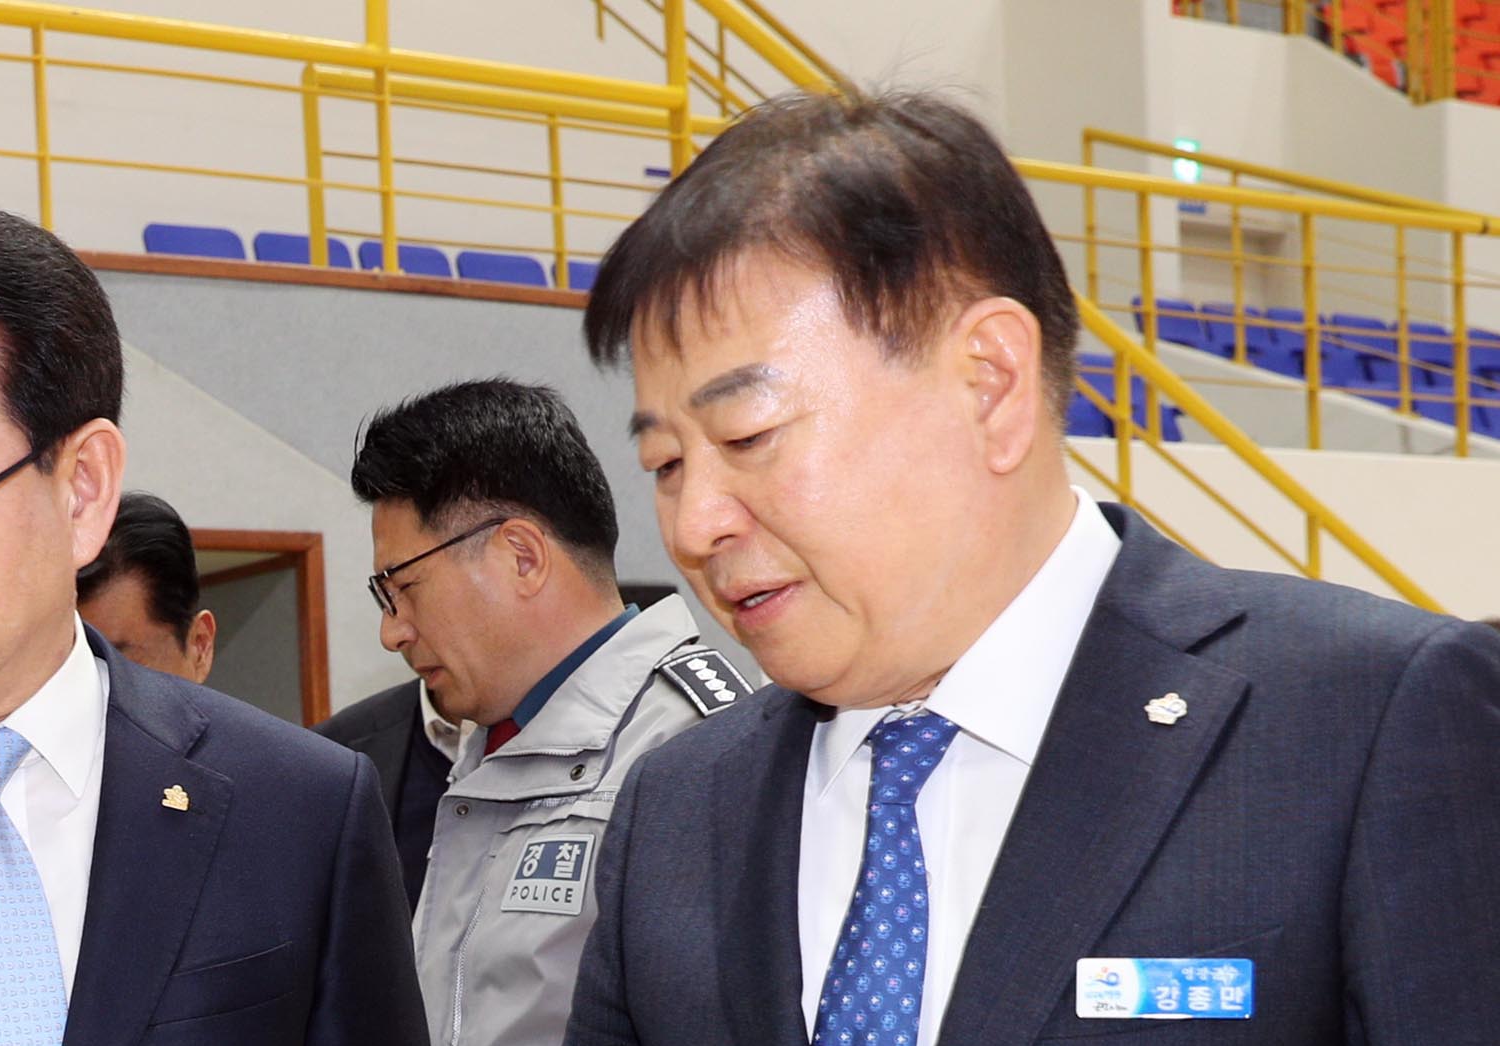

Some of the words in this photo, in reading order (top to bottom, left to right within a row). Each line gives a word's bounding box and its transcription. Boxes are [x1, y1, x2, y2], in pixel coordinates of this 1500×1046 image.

[522, 843, 581, 878] 경찰
[510, 884, 574, 904] POLICE
[1154, 985, 1245, 1011] 강종만
